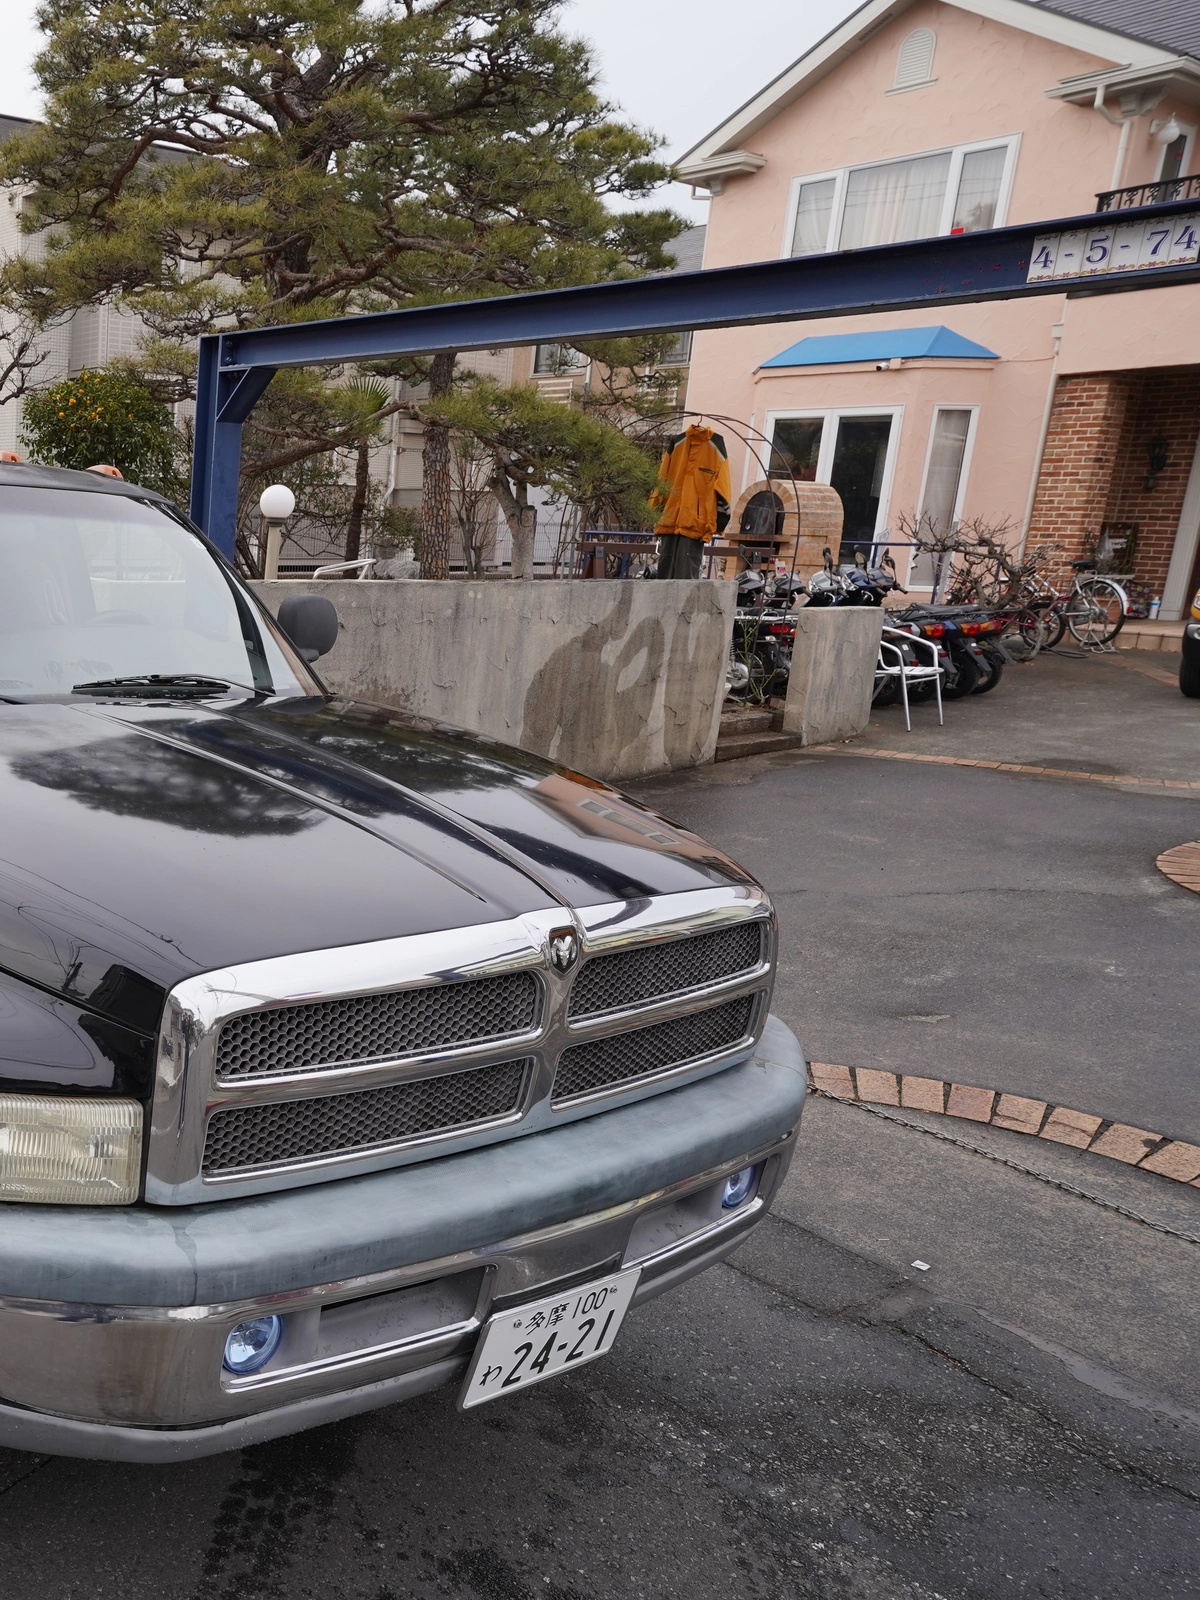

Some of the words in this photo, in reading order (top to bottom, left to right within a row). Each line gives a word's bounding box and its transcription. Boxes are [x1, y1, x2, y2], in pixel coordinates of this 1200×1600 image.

[1032, 224, 1199, 269] 4-5-74
[525, 1302, 570, 1336] 多摩
[573, 1287, 608, 1319] 100
[479, 1365, 503, 1387] わ
[501, 1309, 616, 1389] 24-21
